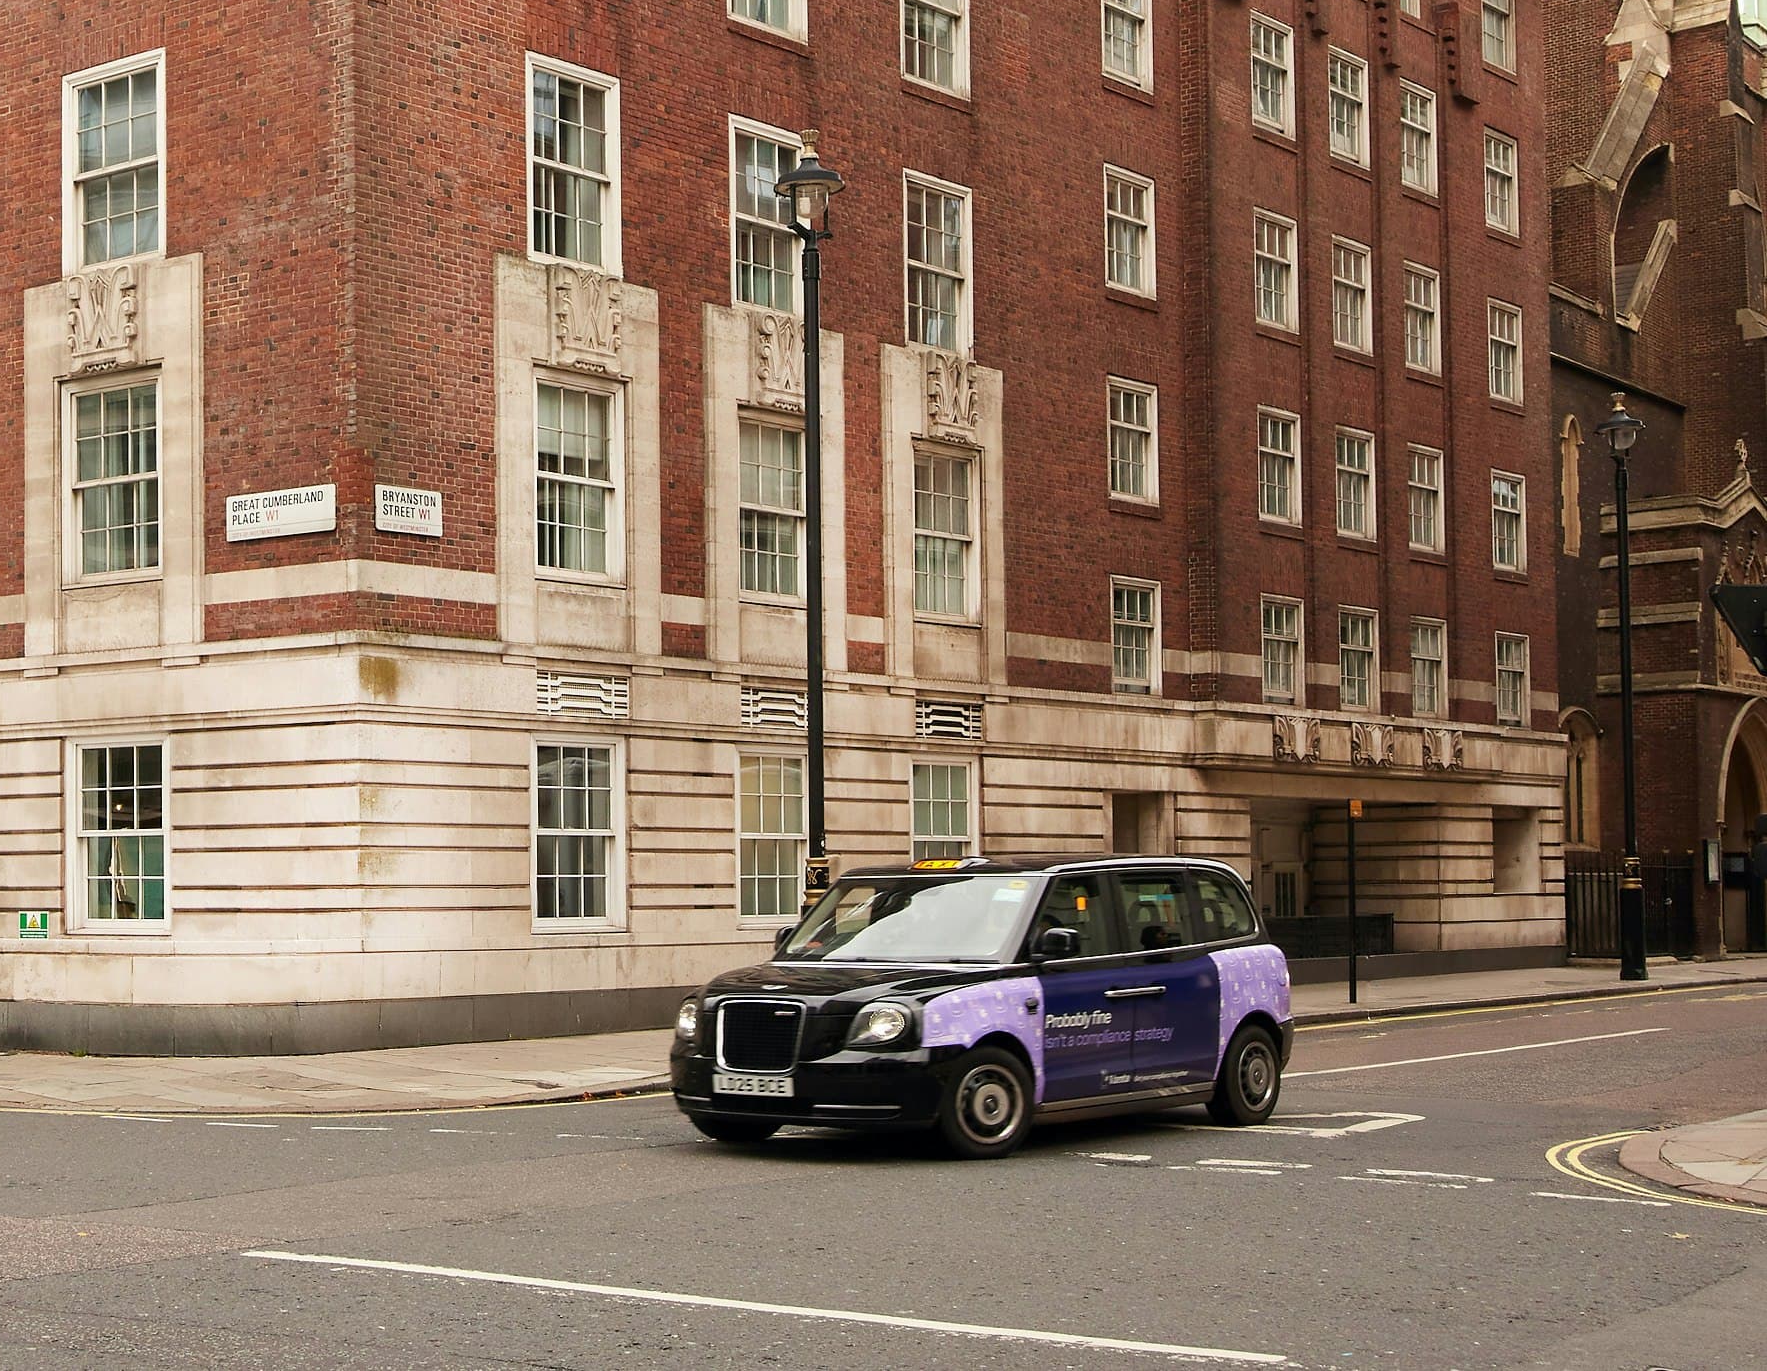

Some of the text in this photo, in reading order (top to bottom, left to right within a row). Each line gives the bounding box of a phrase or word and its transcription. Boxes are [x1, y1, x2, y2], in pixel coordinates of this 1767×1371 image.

[232, 490, 324, 513] GREAT CUMBERLAND
[382, 490, 437, 508] BRYANSTON
[232, 510, 280, 526] PLACE W1
[382, 503, 431, 521] STREET W1
[916, 859, 959, 869] TAXI
[1045, 1010, 1113, 1029] Probably fine
[1076, 1029, 1132, 1047] compliance
[1134, 1027, 1175, 1042] strategy
